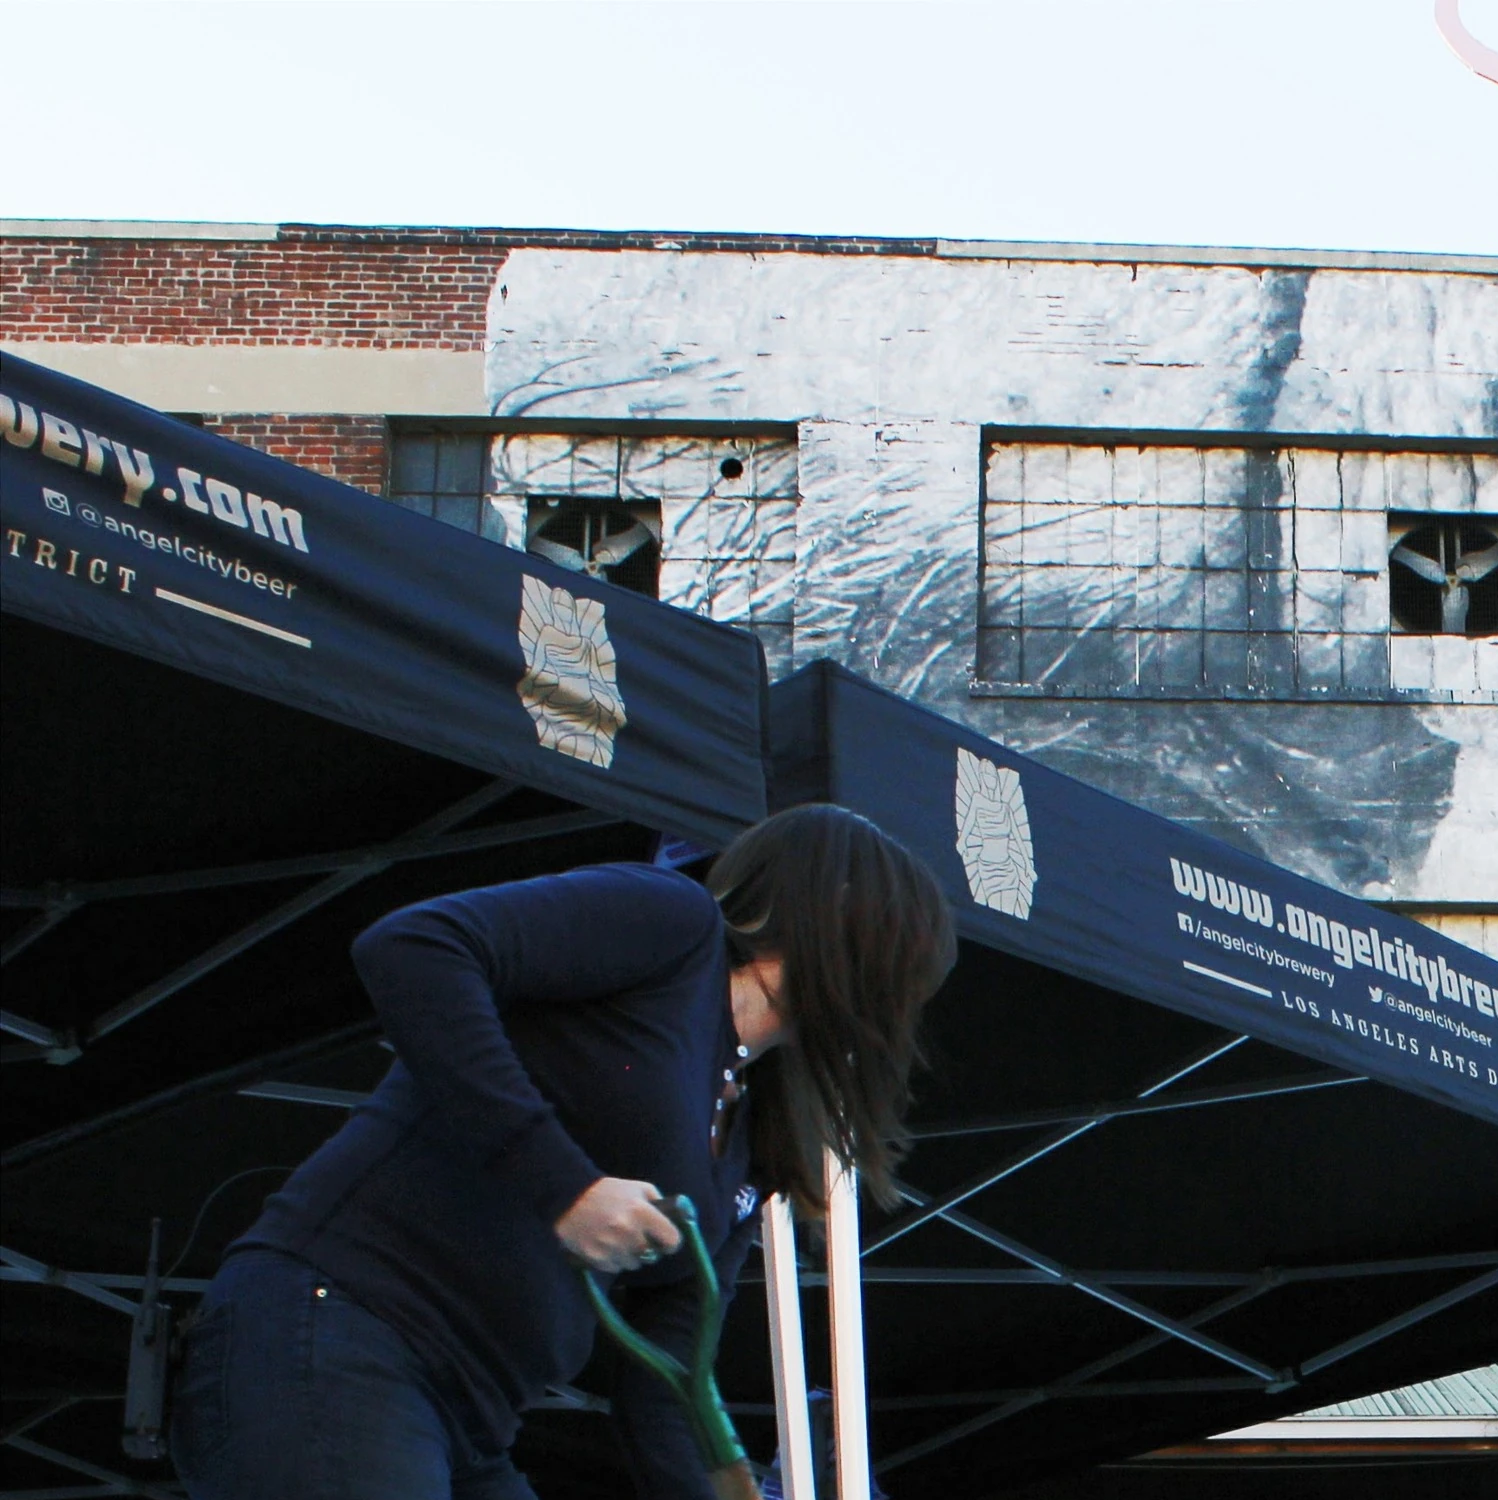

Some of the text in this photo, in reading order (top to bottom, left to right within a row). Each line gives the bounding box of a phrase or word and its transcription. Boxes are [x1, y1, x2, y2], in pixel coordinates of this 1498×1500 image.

[7, 529, 136, 594] TRICT
[76, 502, 298, 600] @angelcitybeer
[1281, 991, 1320, 1018] LOS
[1331, 1009, 1419, 1055] ANGELES
[1430, 1046, 1478, 1078] ARTS
[1384, 992, 1493, 1048] @angelcitybeer
